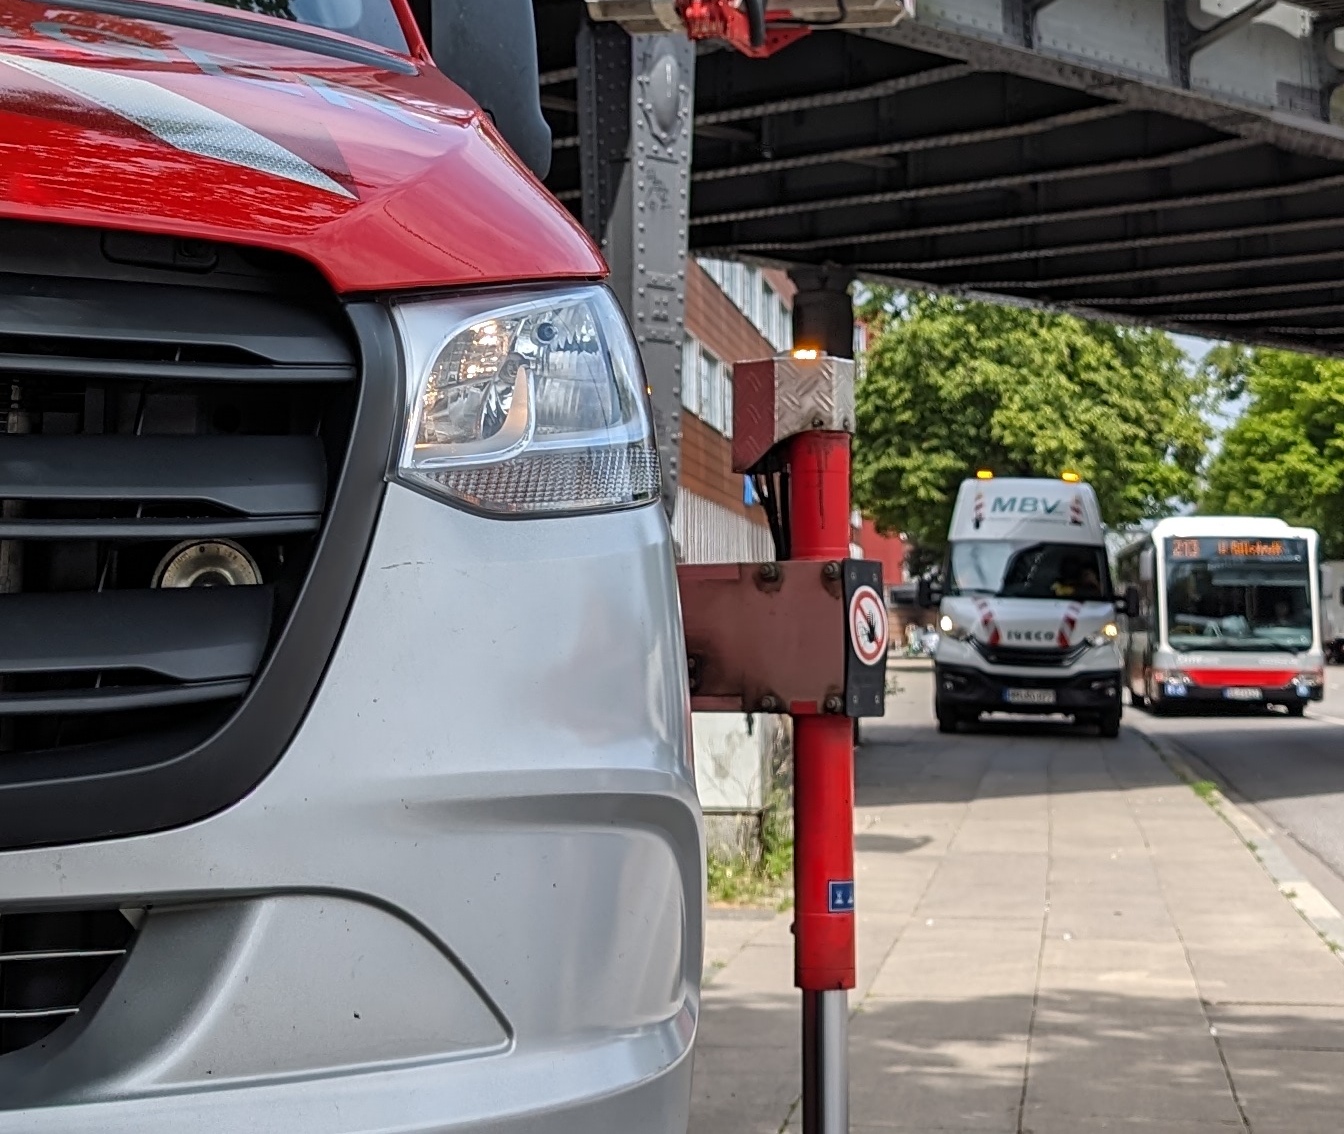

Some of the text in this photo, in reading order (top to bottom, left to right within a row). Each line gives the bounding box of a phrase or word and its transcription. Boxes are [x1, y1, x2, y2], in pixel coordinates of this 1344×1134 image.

[991, 496, 1061, 514] MBV
[1172, 539, 1200, 557] 213
[1007, 630, 1055, 641] IVECO
